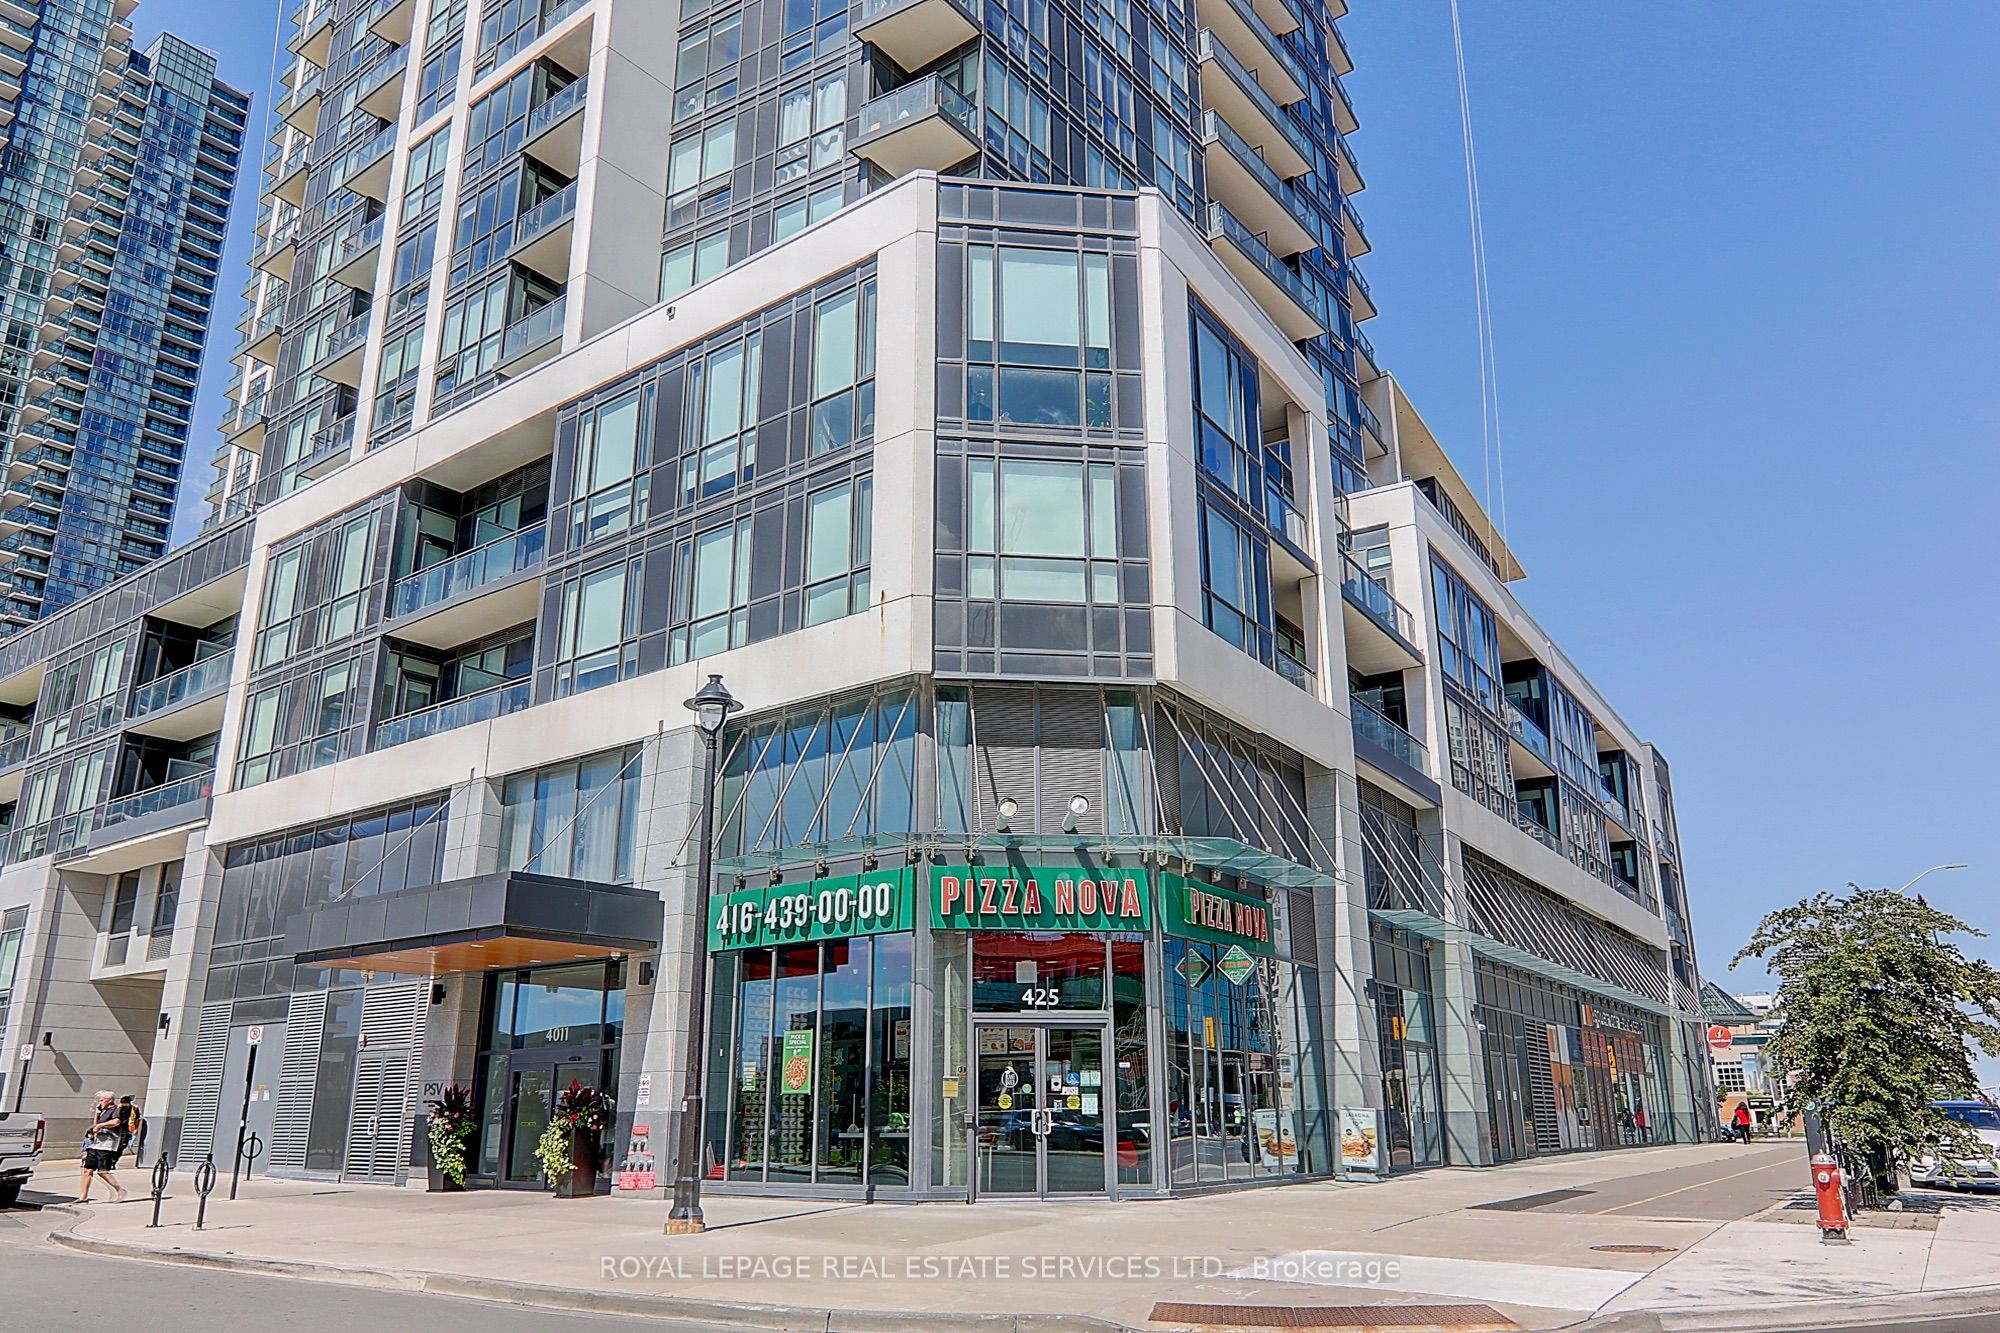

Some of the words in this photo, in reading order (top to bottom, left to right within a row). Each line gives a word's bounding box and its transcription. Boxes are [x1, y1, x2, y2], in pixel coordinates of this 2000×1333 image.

[940, 876, 1042, 916] PIZZA
[1054, 878, 1142, 918] NOVA
[1189, 887, 1233, 932] PIZZA
[1235, 902, 1269, 943] NOVA
[1021, 988, 1060, 1006] 425
[545, 1027, 569, 1042] 4011
[423, 1082, 444, 1096] PSV
